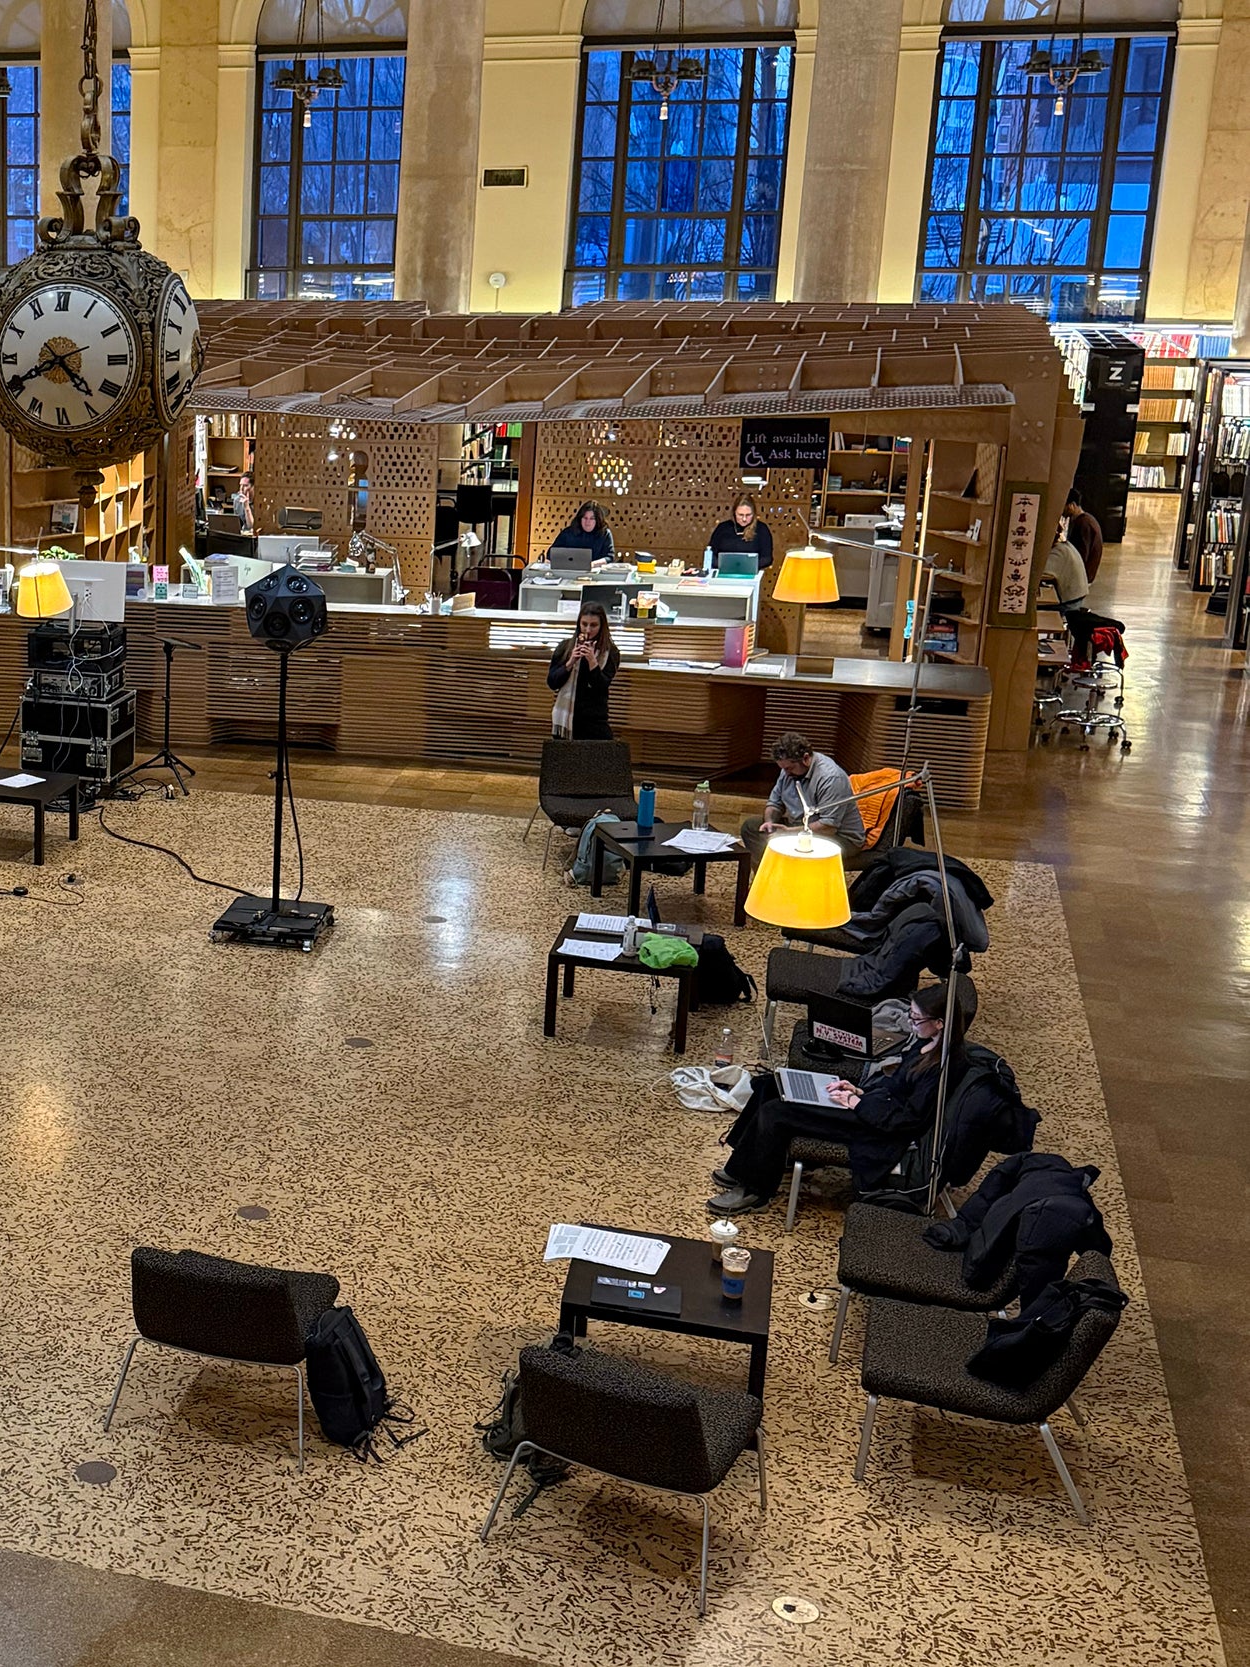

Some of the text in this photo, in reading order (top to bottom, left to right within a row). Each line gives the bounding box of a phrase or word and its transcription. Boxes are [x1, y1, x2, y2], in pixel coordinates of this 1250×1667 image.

[107, 354, 128, 366] III
[1109, 367, 1123, 380] Z
[746, 433, 826, 444] Lift available
[768, 449, 826, 460] Ask here!
